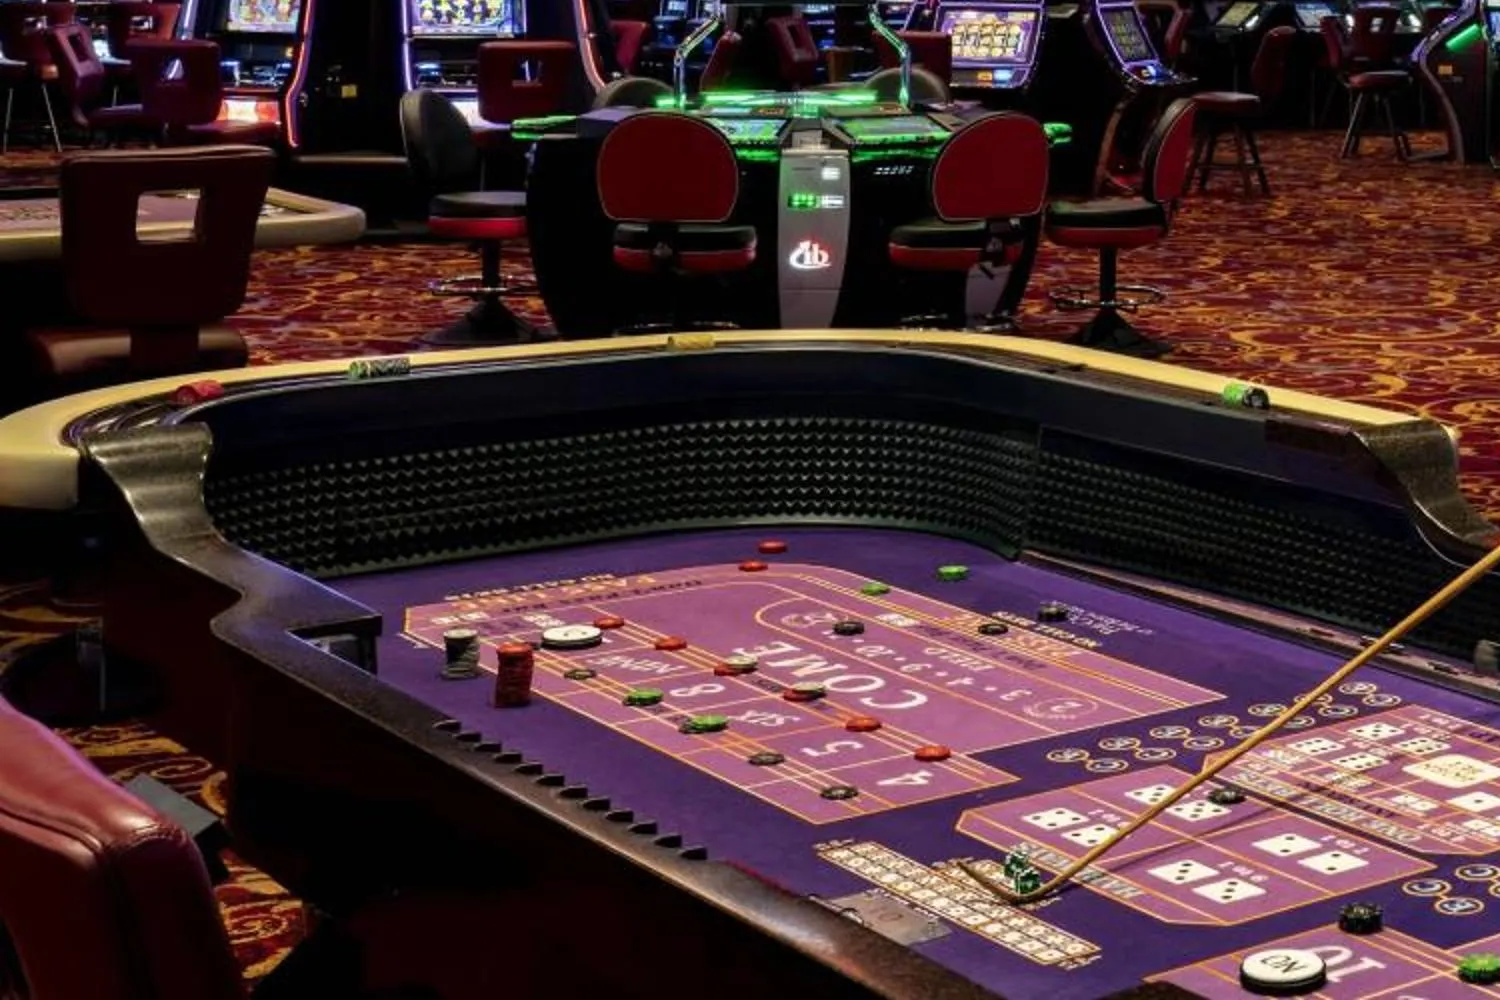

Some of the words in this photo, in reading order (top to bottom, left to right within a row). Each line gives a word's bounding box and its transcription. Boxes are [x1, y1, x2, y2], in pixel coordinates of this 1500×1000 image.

[736, 641, 926, 707] COME
[669, 683, 726, 697] 8
[802, 741, 862, 757] 5
[877, 770, 933, 786] 4
